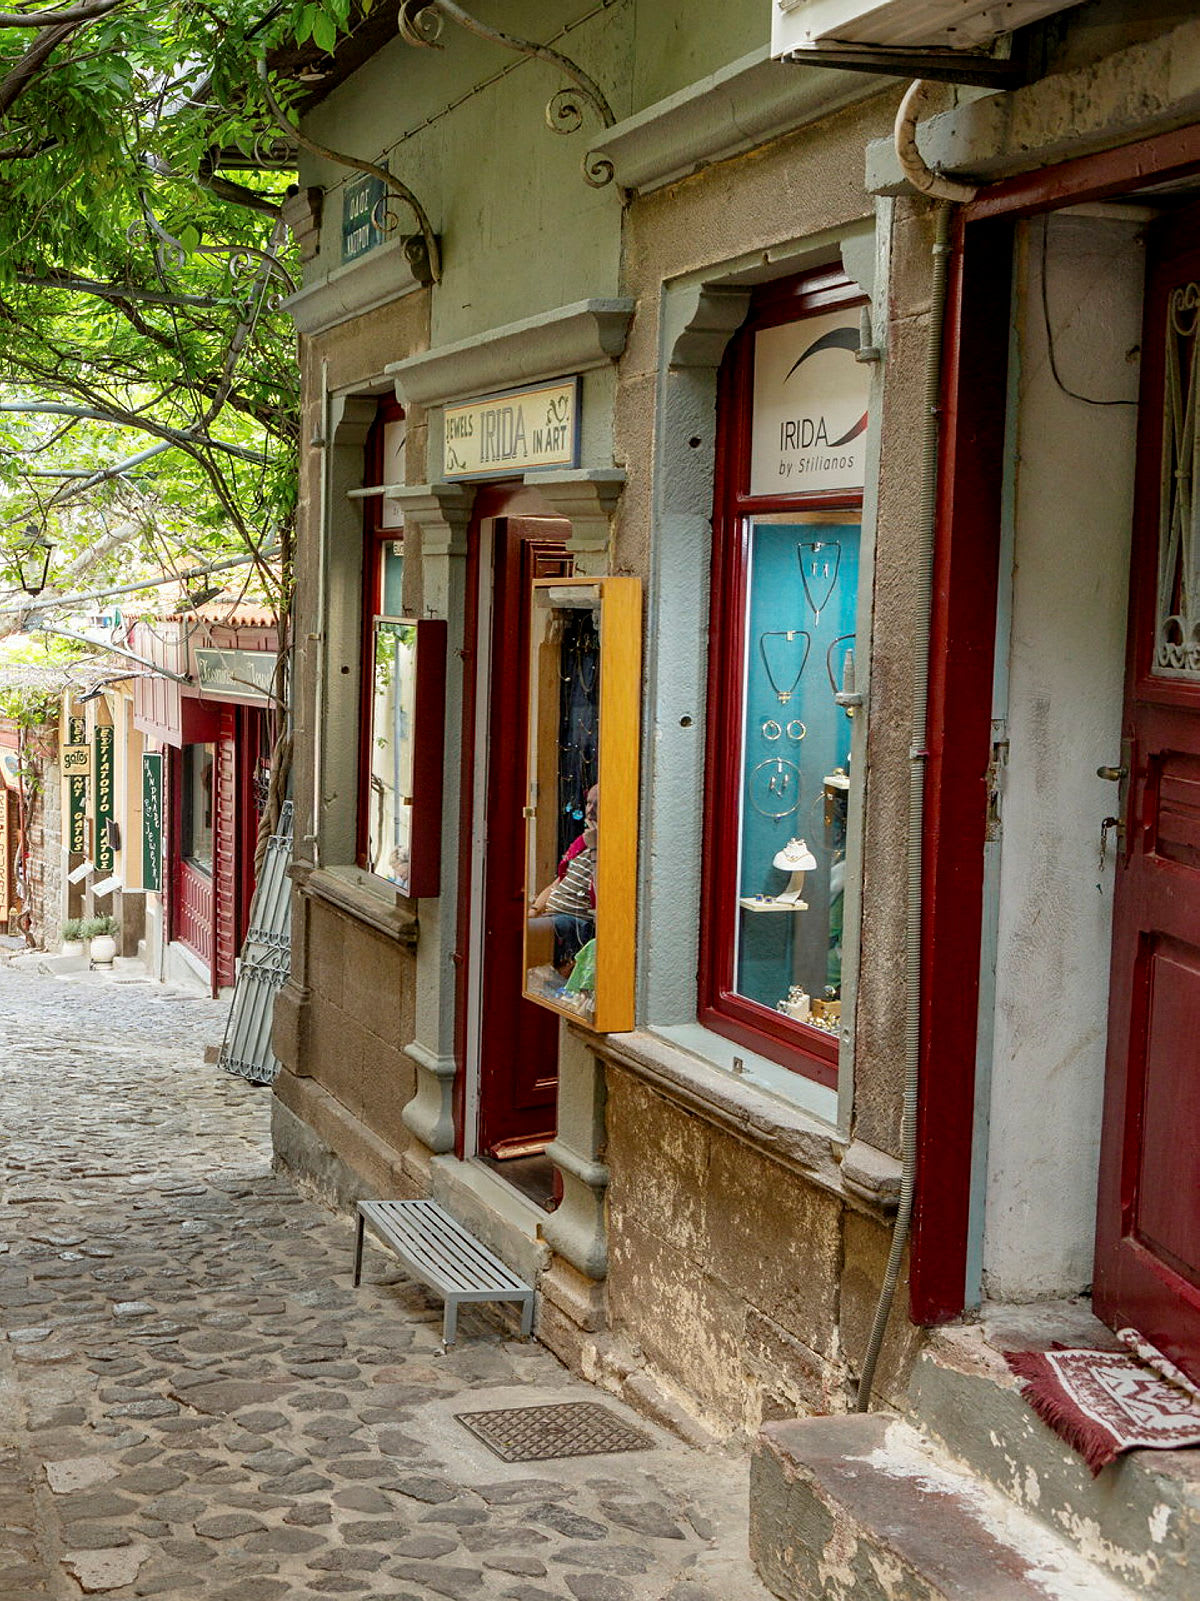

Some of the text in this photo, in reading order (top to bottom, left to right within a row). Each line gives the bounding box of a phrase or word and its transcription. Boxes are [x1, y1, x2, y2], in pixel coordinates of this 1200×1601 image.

[446, 414, 473, 444] JEWELS
[480, 403, 528, 463] IRIDA
[533, 425, 567, 454] IN ART
[780, 415, 829, 452] IRIDA
[778, 456, 855, 478] by Stilianos
[64, 750, 88, 769] gatos
